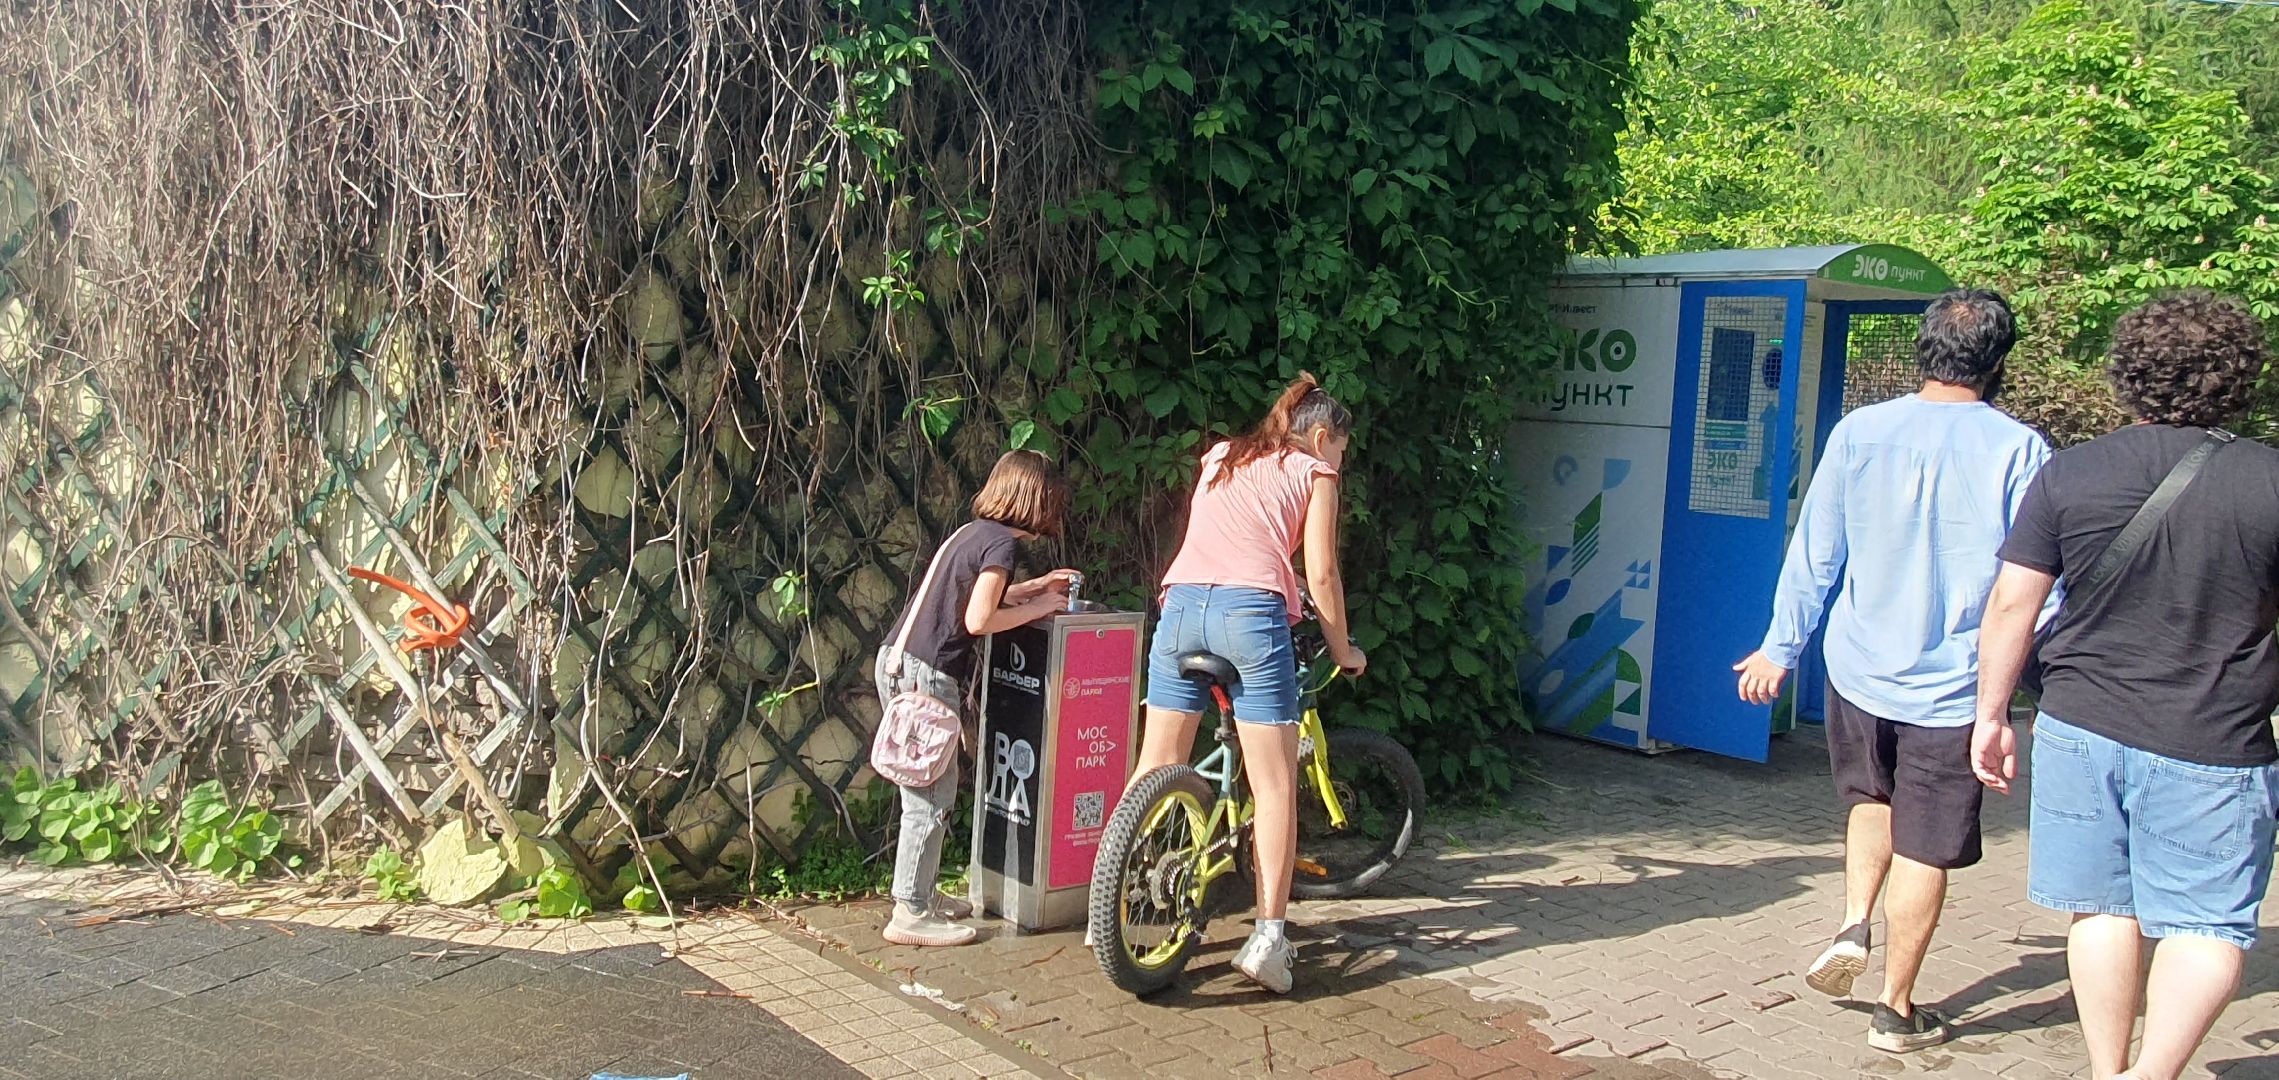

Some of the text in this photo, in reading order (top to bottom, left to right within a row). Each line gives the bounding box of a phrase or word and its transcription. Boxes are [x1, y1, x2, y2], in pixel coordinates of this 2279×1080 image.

[1852, 254, 1927, 282] ЭКО пункт
[1538, 328, 1637, 373] КО
[1708, 451, 1738, 470] ЭКО
[993, 667, 1040, 689] БАРЬЕР
[1077, 726, 1108, 740] МОС
[1076, 755, 1107, 769] ПАРК
